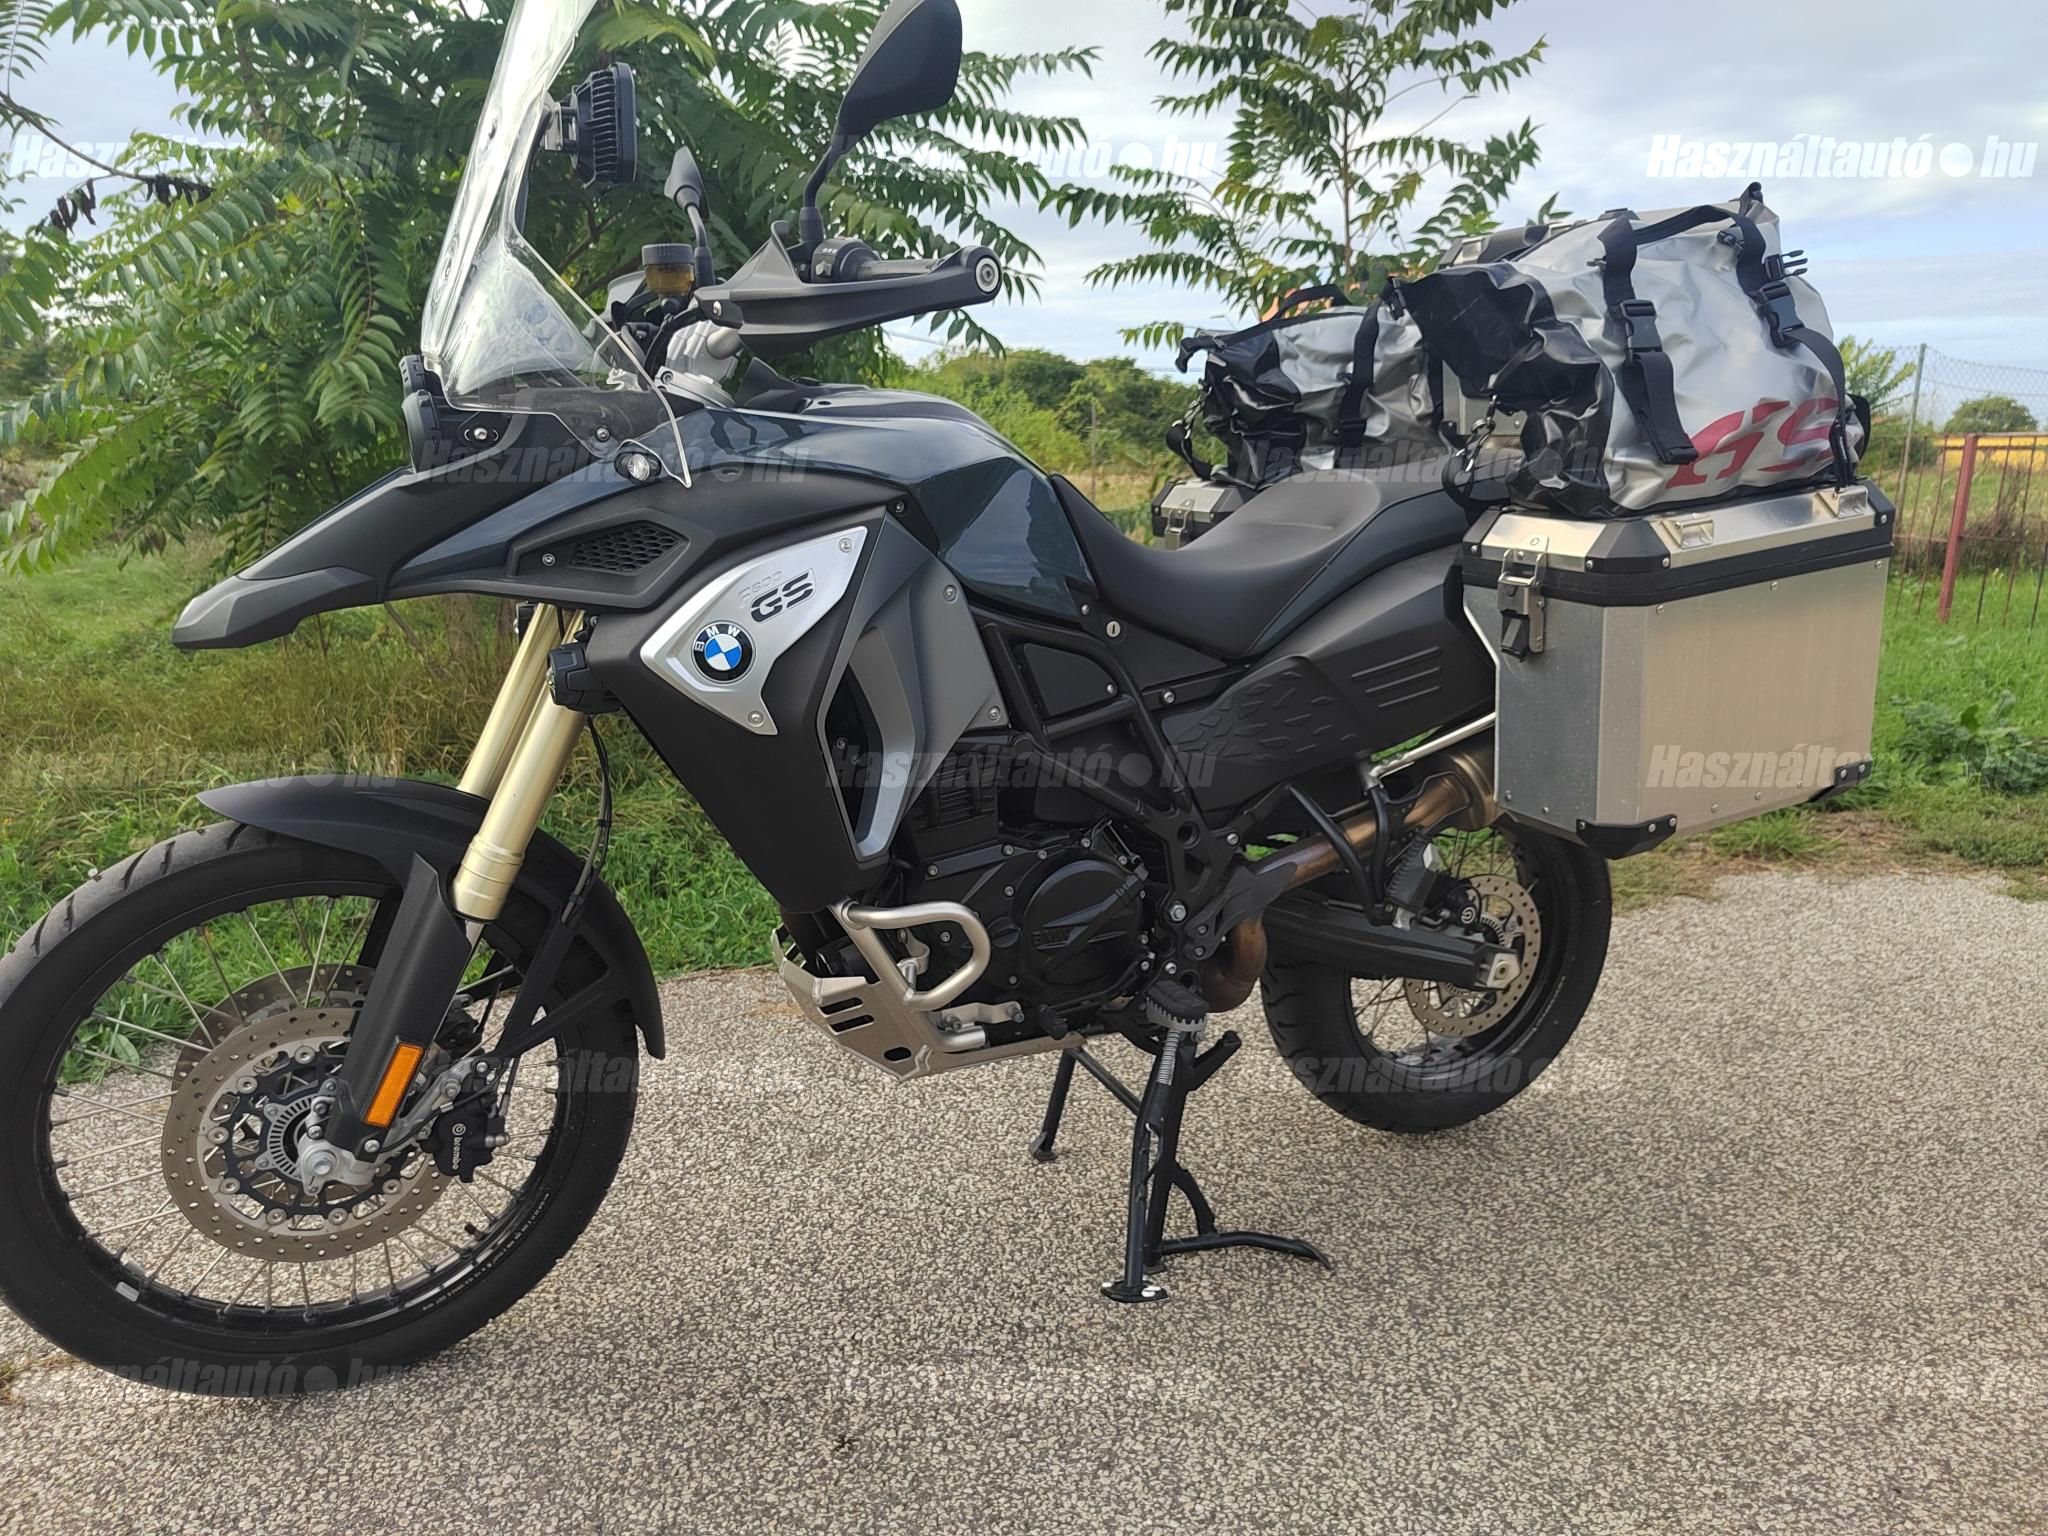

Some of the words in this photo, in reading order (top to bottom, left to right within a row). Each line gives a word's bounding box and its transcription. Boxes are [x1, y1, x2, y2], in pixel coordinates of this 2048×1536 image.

[1665, 397, 1839, 489] GS
[750, 571, 815, 623] GS
[694, 624, 742, 653] BMW
[452, 1136, 464, 1170] brembo
